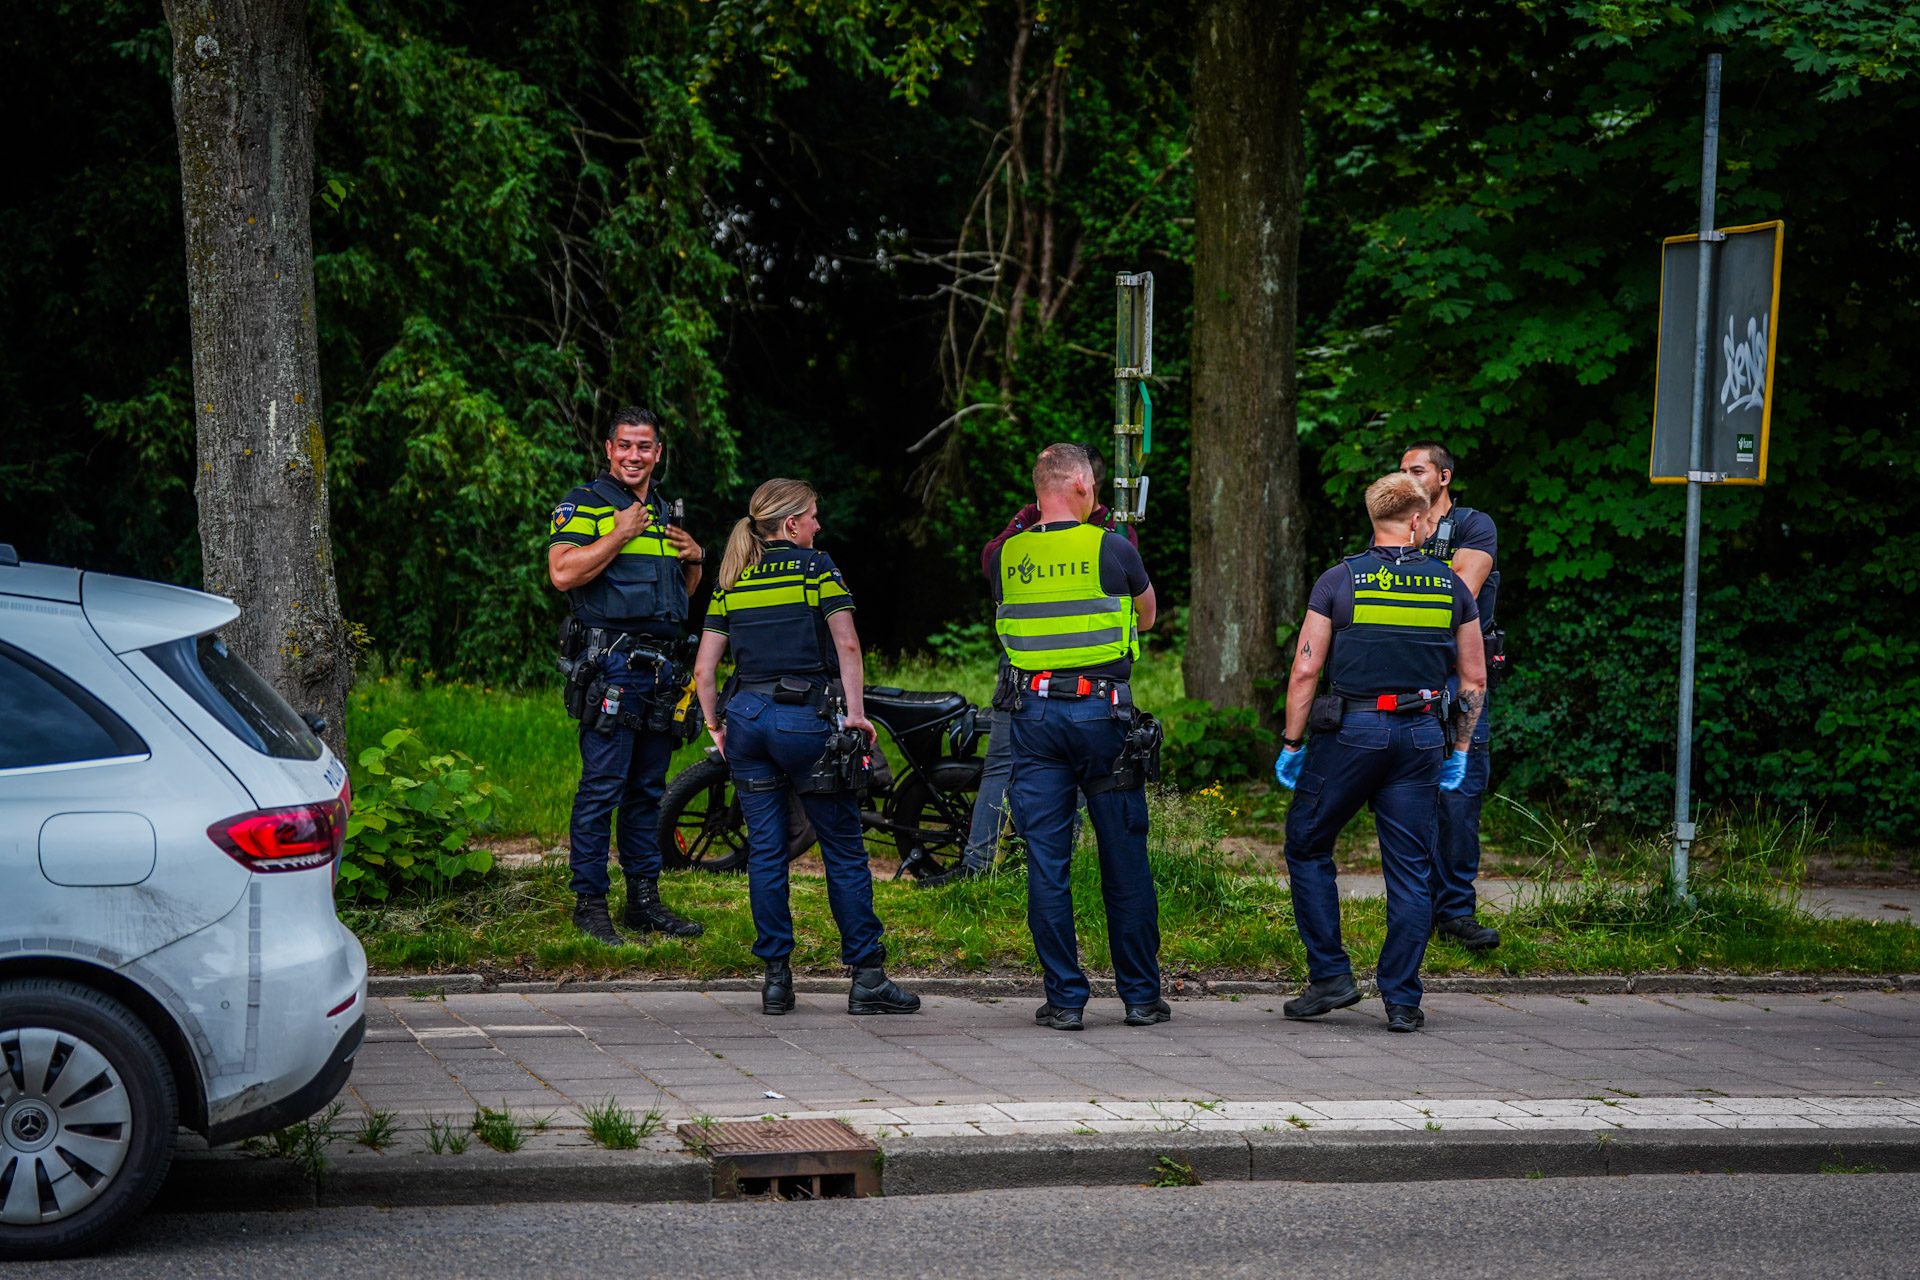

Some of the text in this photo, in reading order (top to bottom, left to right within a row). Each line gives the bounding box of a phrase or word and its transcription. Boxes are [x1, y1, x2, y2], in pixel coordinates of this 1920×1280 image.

[741, 560, 796, 580] OLITIE
[1007, 553, 1089, 584] POLITIE
[1366, 565, 1442, 590] POLITIE
